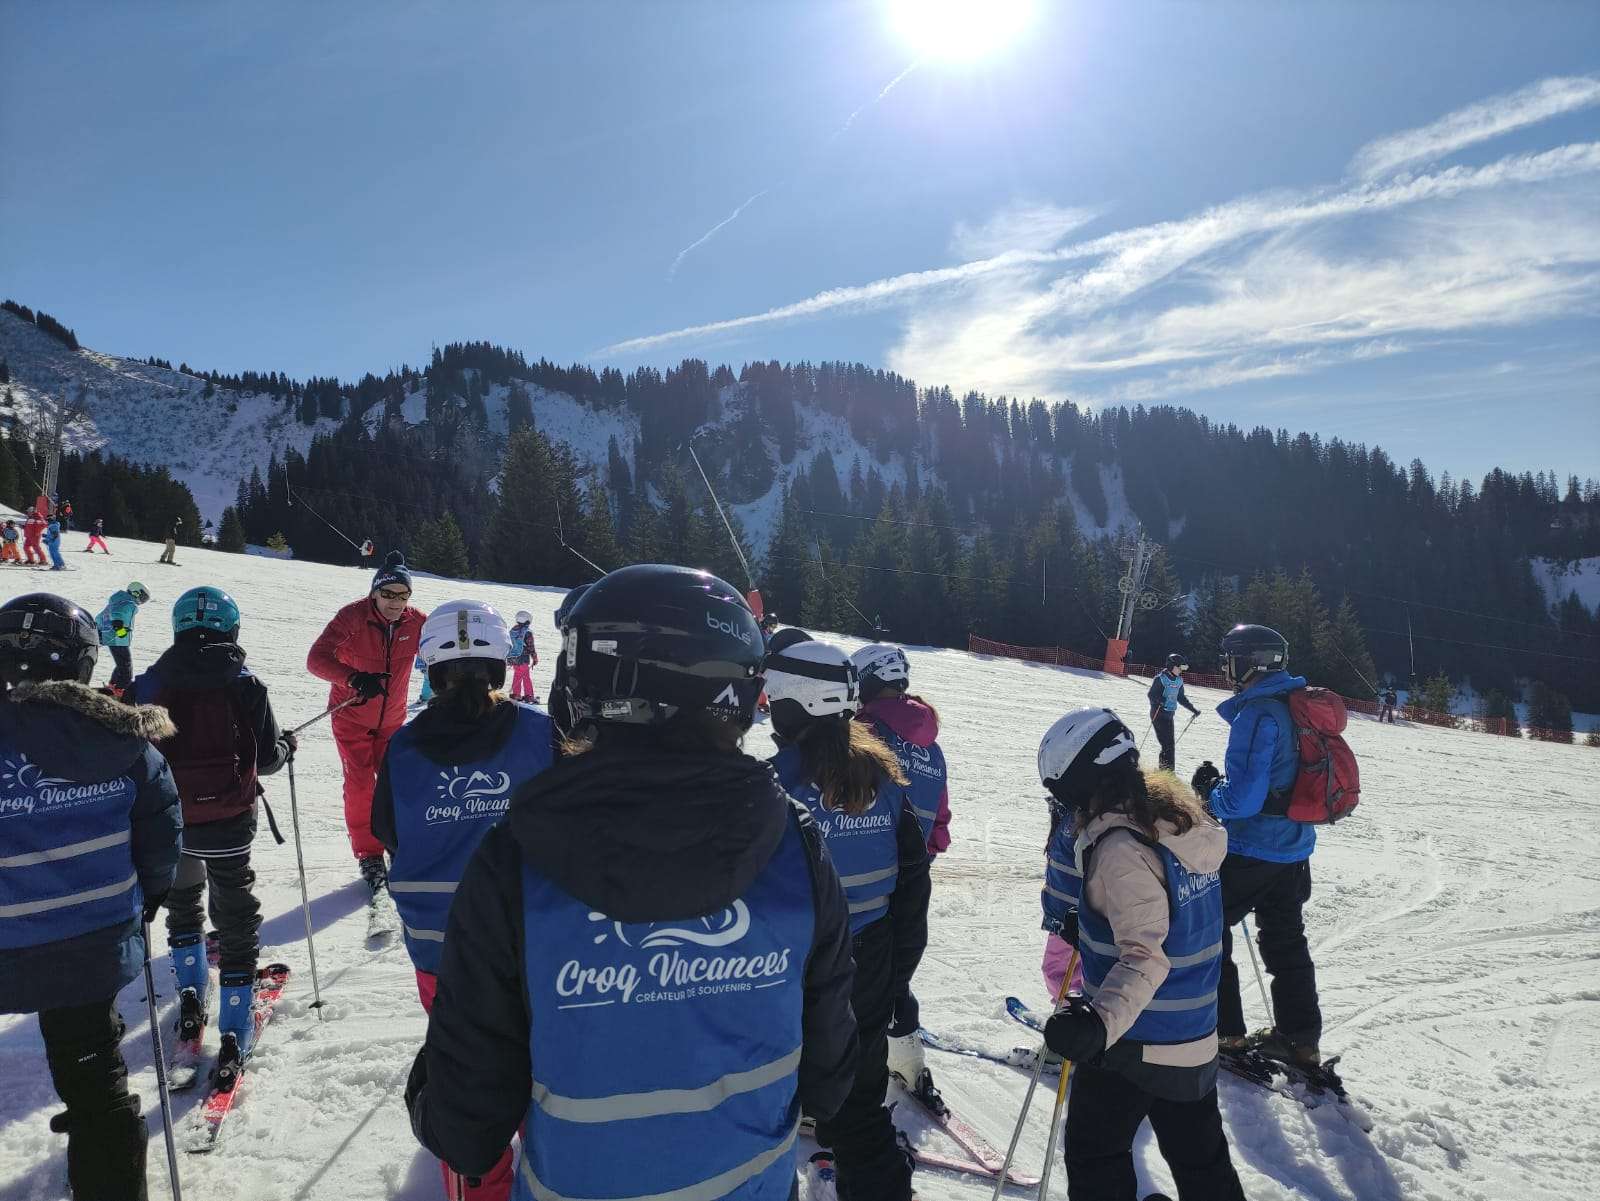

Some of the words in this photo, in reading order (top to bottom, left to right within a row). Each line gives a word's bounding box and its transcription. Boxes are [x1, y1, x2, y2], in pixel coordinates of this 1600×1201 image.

[0, 796, 36, 814] roq
[40, 777, 125, 804] Vacances
[425, 805, 463, 821] Croq
[466, 797, 511, 814] Vacan
[556, 960, 641, 1003] Croq
[648, 948, 791, 987] Vacances
[635, 990, 686, 1004] CRÉATEUR
[686, 988, 697, 999] DE
[698, 983, 753, 996] SOUVENIRS
